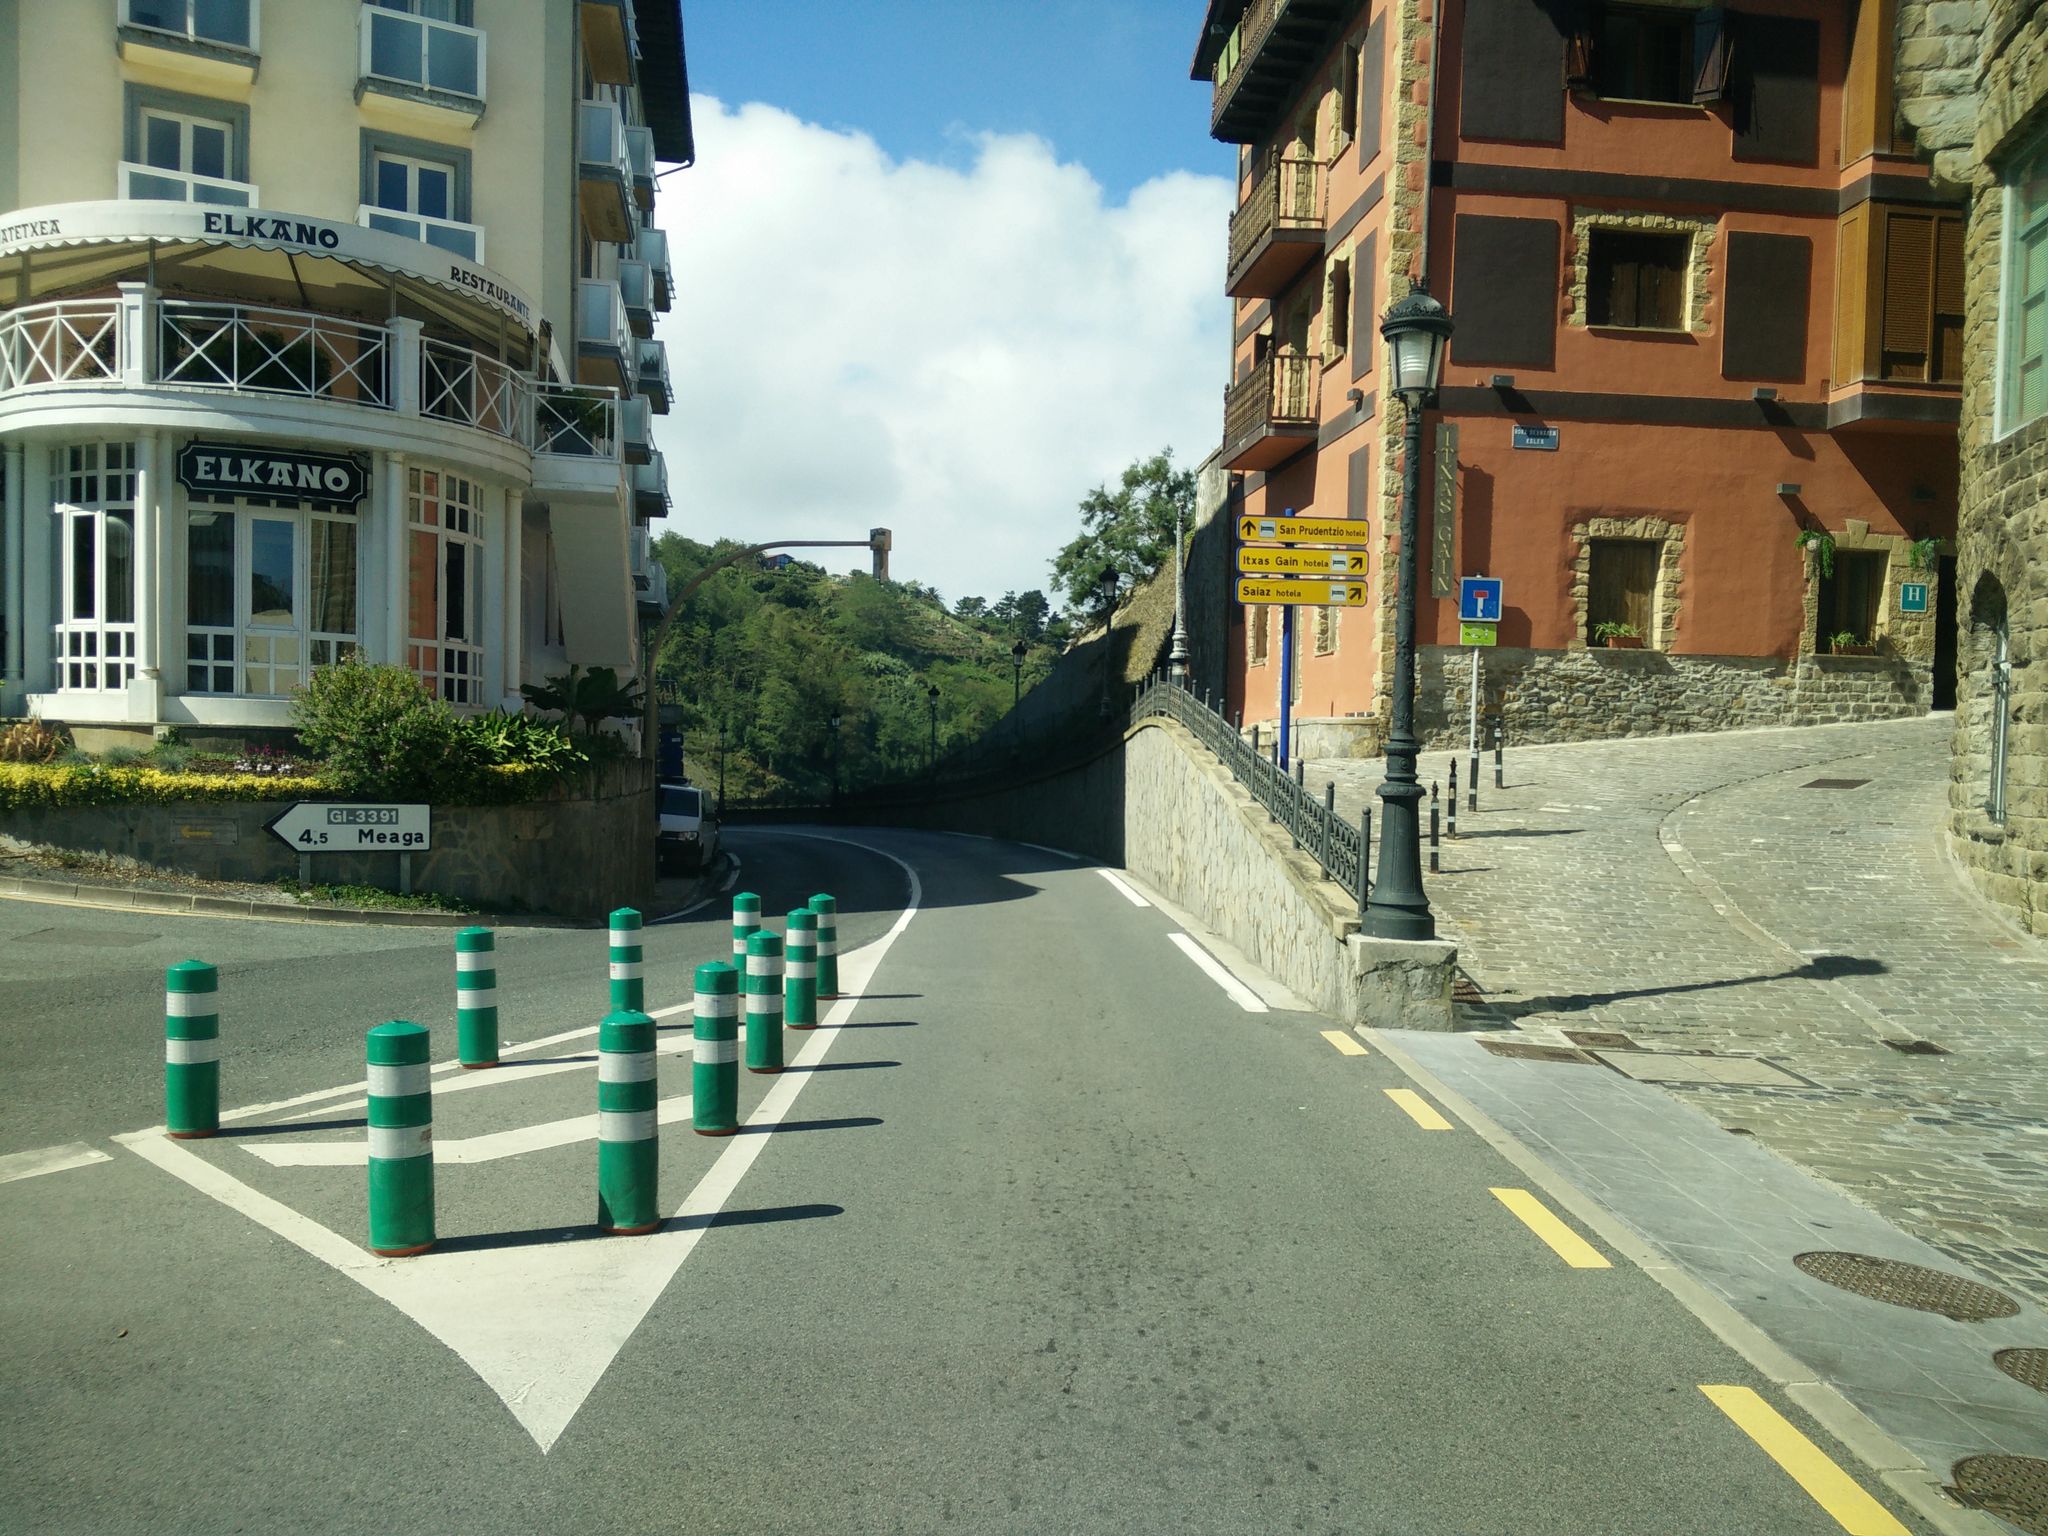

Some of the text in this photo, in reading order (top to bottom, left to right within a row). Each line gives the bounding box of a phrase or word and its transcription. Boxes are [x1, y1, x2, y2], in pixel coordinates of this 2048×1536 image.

[204, 211, 340, 250] ELKANO
[450, 265, 530, 320] RESTAURANTE
[195, 455, 350, 493] ELKANO
[1279, 525, 1366, 538] San Prudentzio hotela
[1243, 555, 1329, 568] Itxas Gain hotela
[1242, 586, 1302, 598] Saiaz hotela
[1908, 587, 1921, 601] H
[329, 810, 398, 823] GI-3391
[299, 829, 424, 846] 4,5 Meaga
